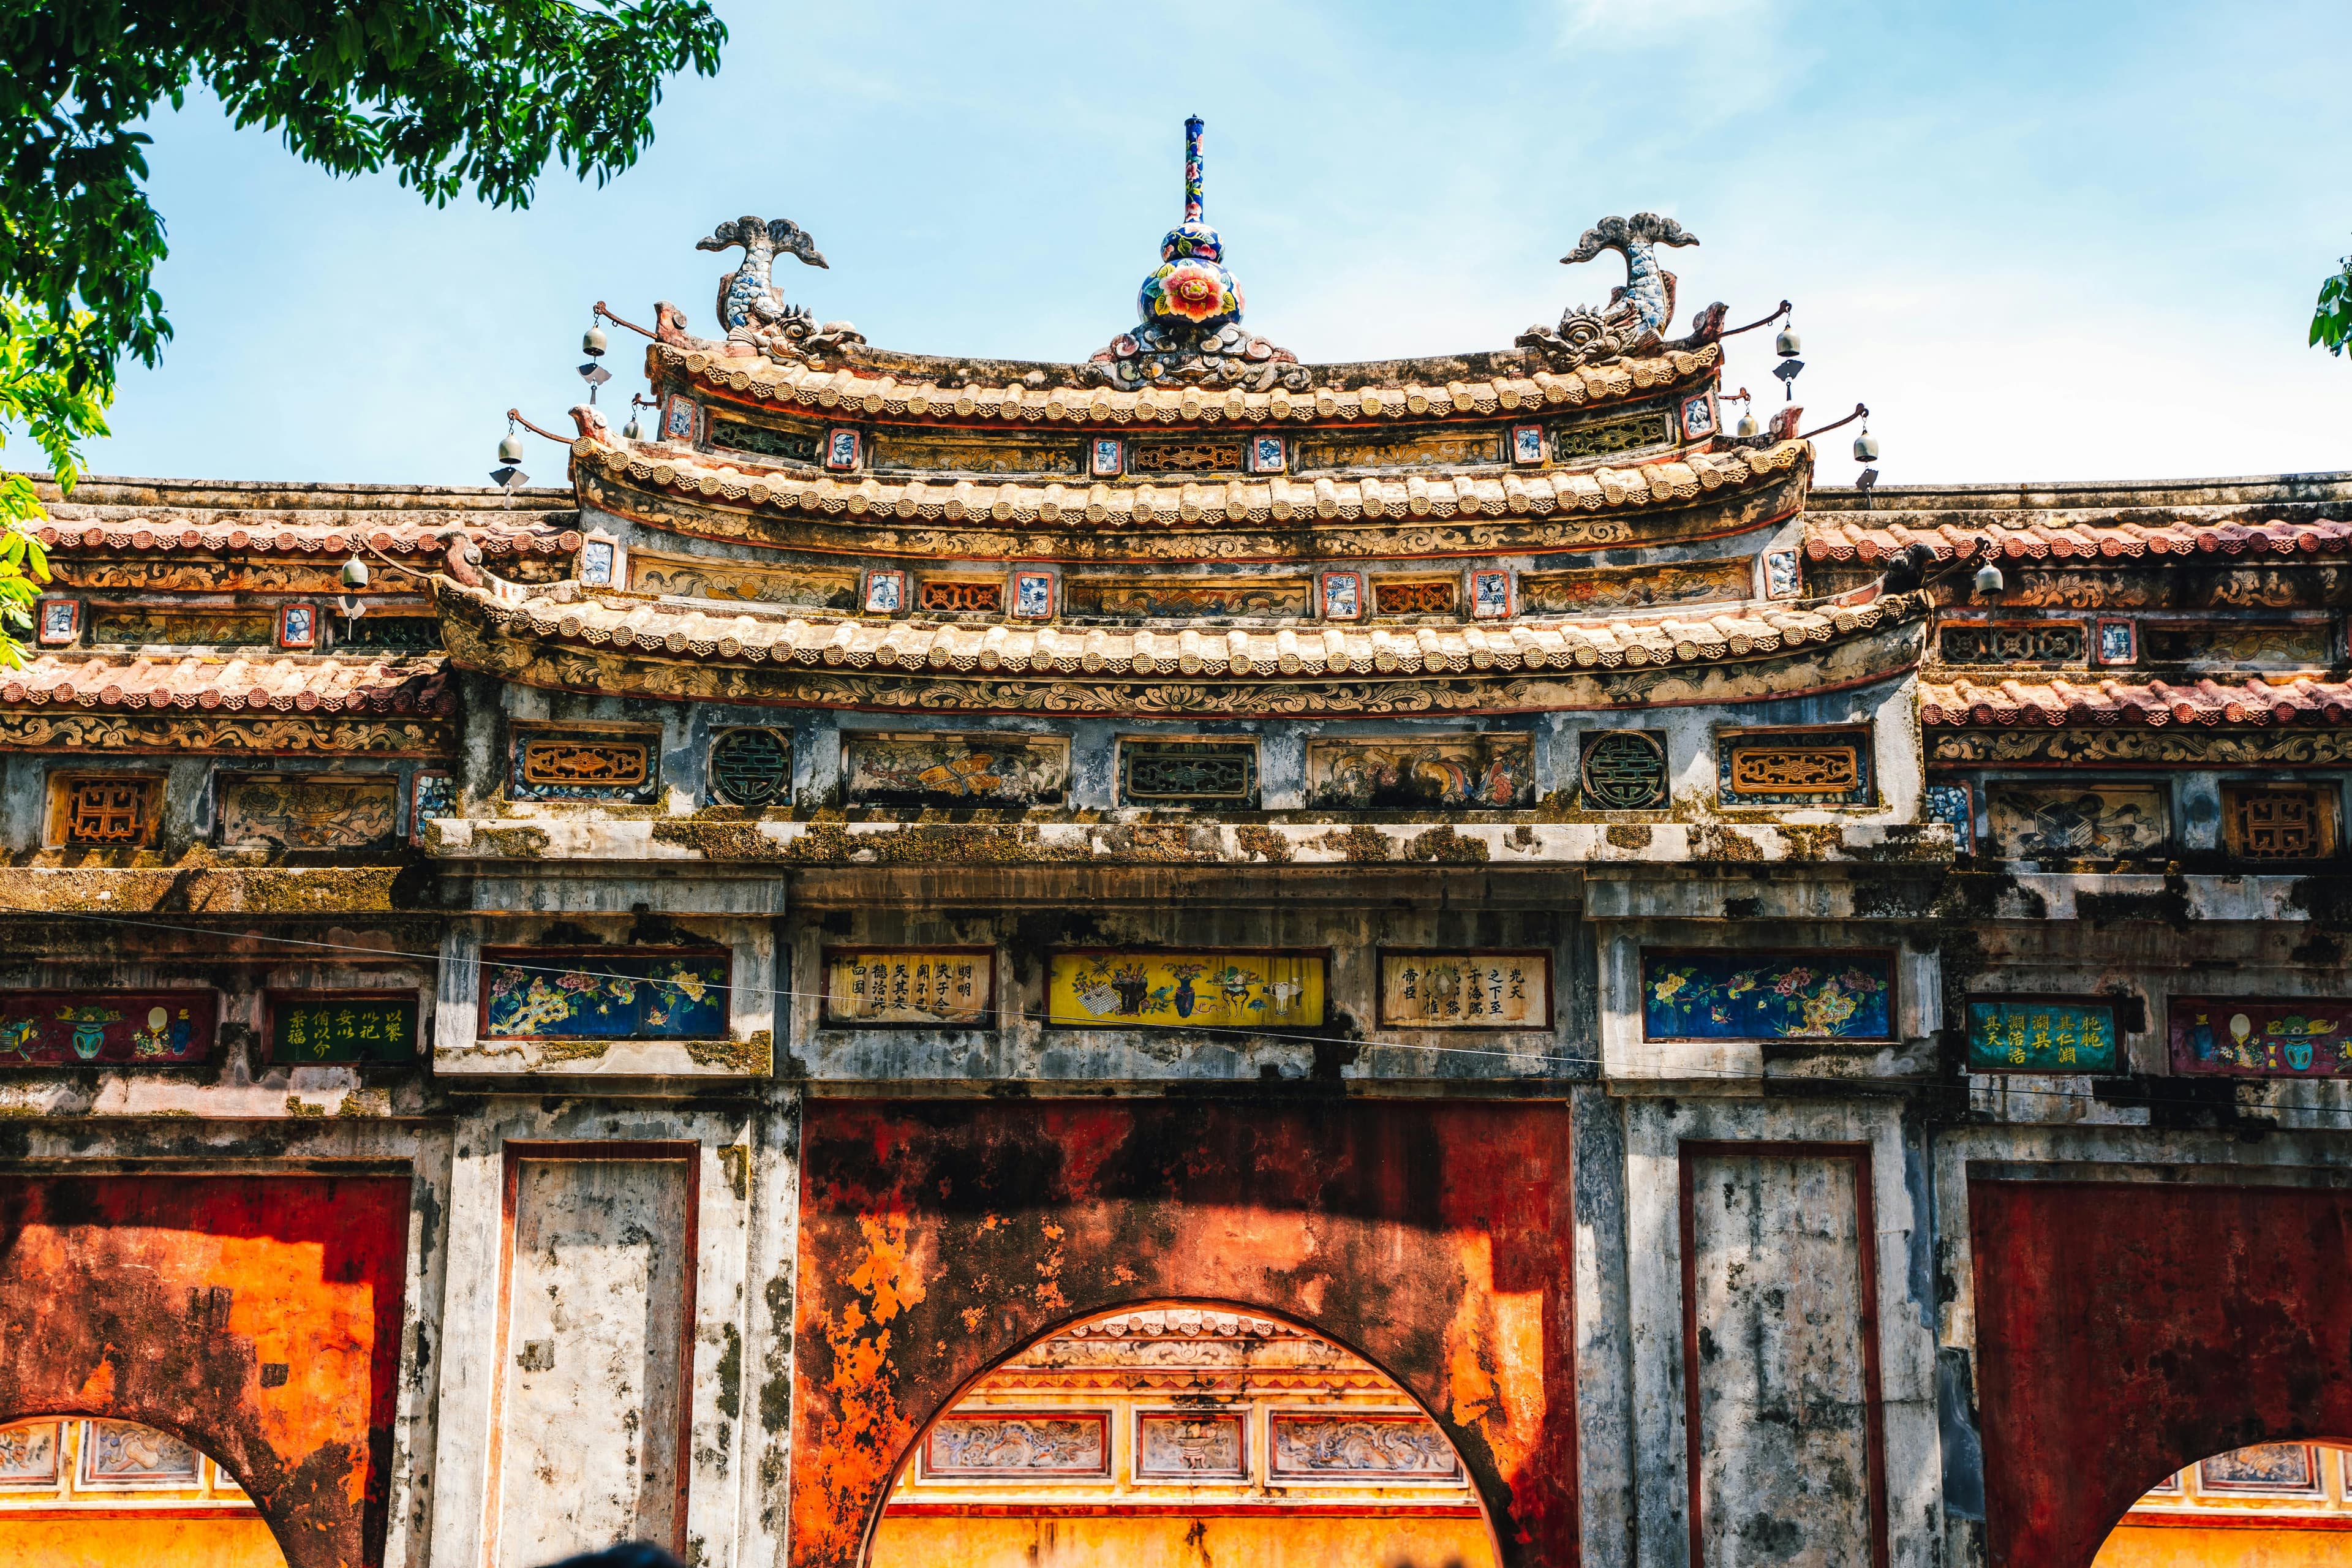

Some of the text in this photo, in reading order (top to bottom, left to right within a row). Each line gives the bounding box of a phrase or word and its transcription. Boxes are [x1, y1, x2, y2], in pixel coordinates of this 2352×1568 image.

[852, 966, 867, 995] 四國
[934, 964, 952, 1011] 天子令
[958, 965, 971, 997] 明明
[1402, 968, 1419, 1000] 帝臣
[1488, 969, 1504, 1014] 之下至
[1509, 968, 1525, 1000] 光天
[287, 1009, 307, 1045] 景福
